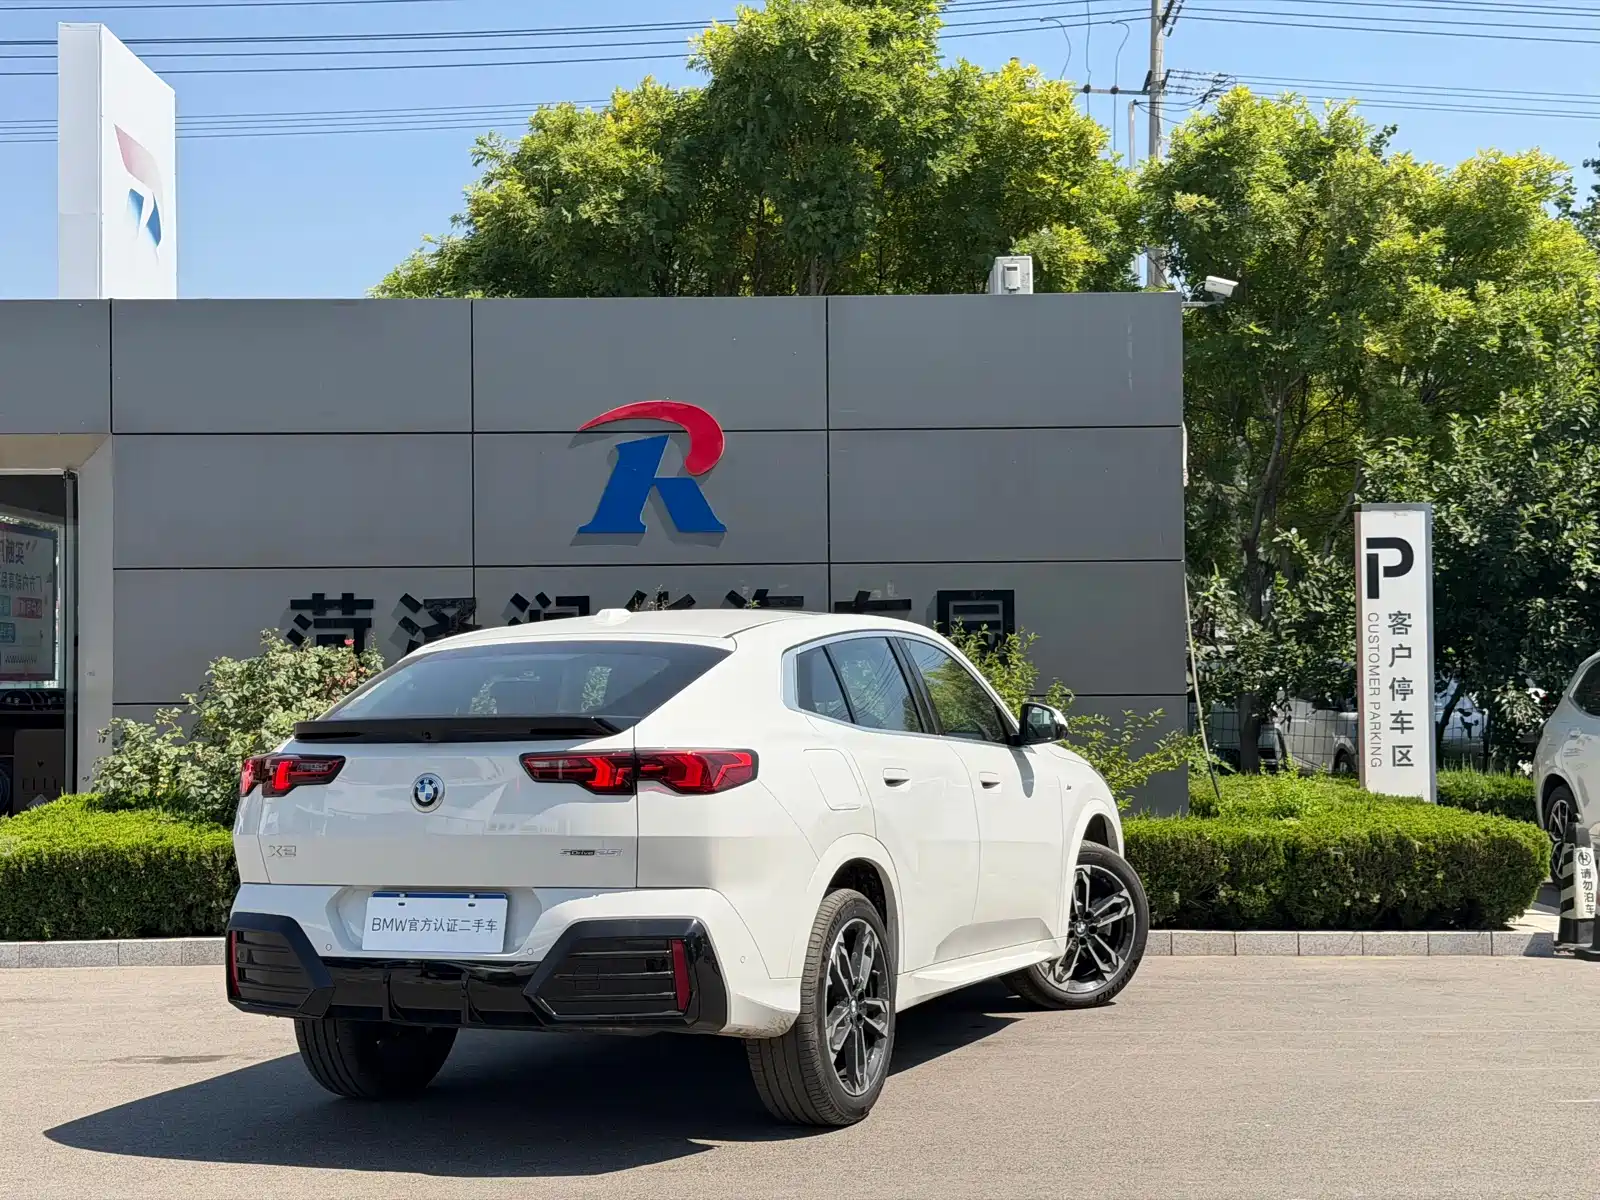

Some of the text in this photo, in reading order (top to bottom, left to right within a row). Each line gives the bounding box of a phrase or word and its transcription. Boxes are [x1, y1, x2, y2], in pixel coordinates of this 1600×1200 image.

[1366, 537, 1414, 599] P
[1367, 612, 1382, 768] CUSTOMER PARKING
[1387, 610, 1414, 767] 客户停车区
[1580, 868, 1596, 915] 请勿泊车
[371, 917, 498, 933] BMW官方认证二手车
